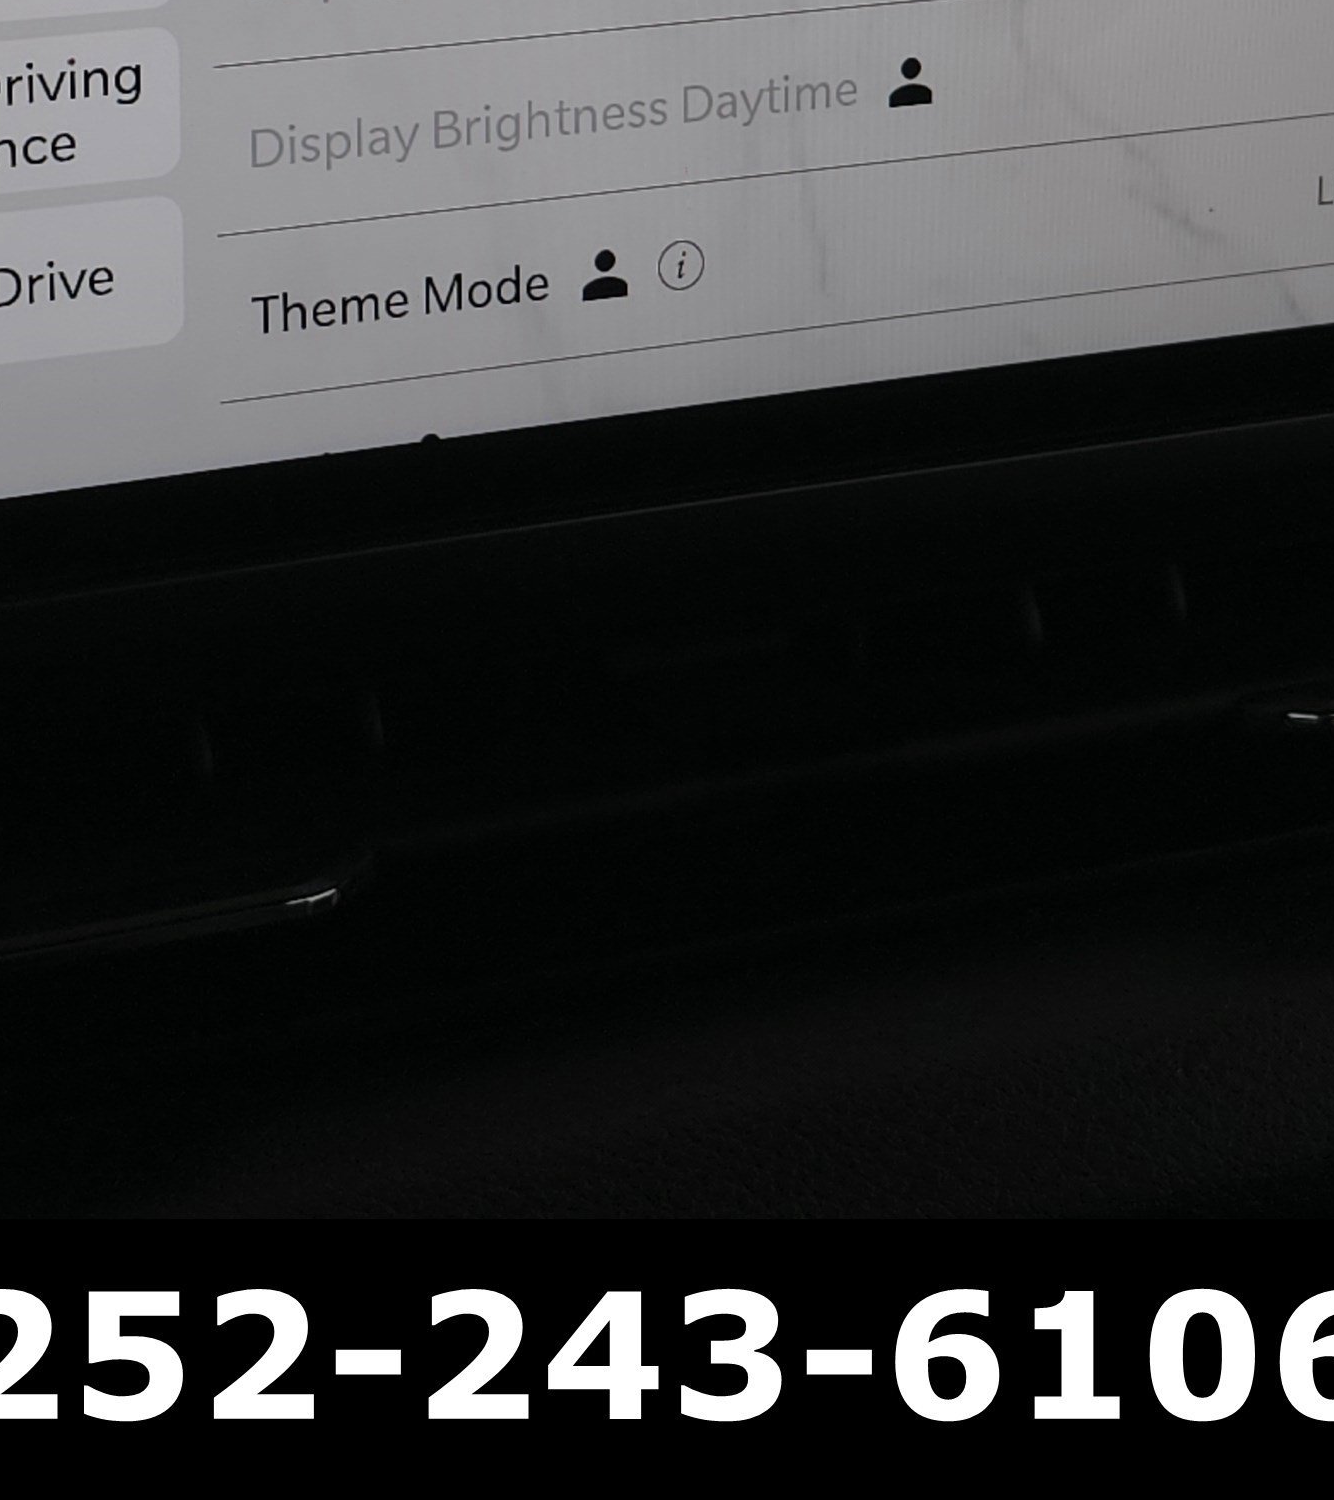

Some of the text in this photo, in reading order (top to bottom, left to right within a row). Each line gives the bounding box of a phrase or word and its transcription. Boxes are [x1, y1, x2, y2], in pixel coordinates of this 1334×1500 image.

[250, 74, 858, 171] Display Brightness Daytime
[251, 264, 549, 334] Theme Mode
